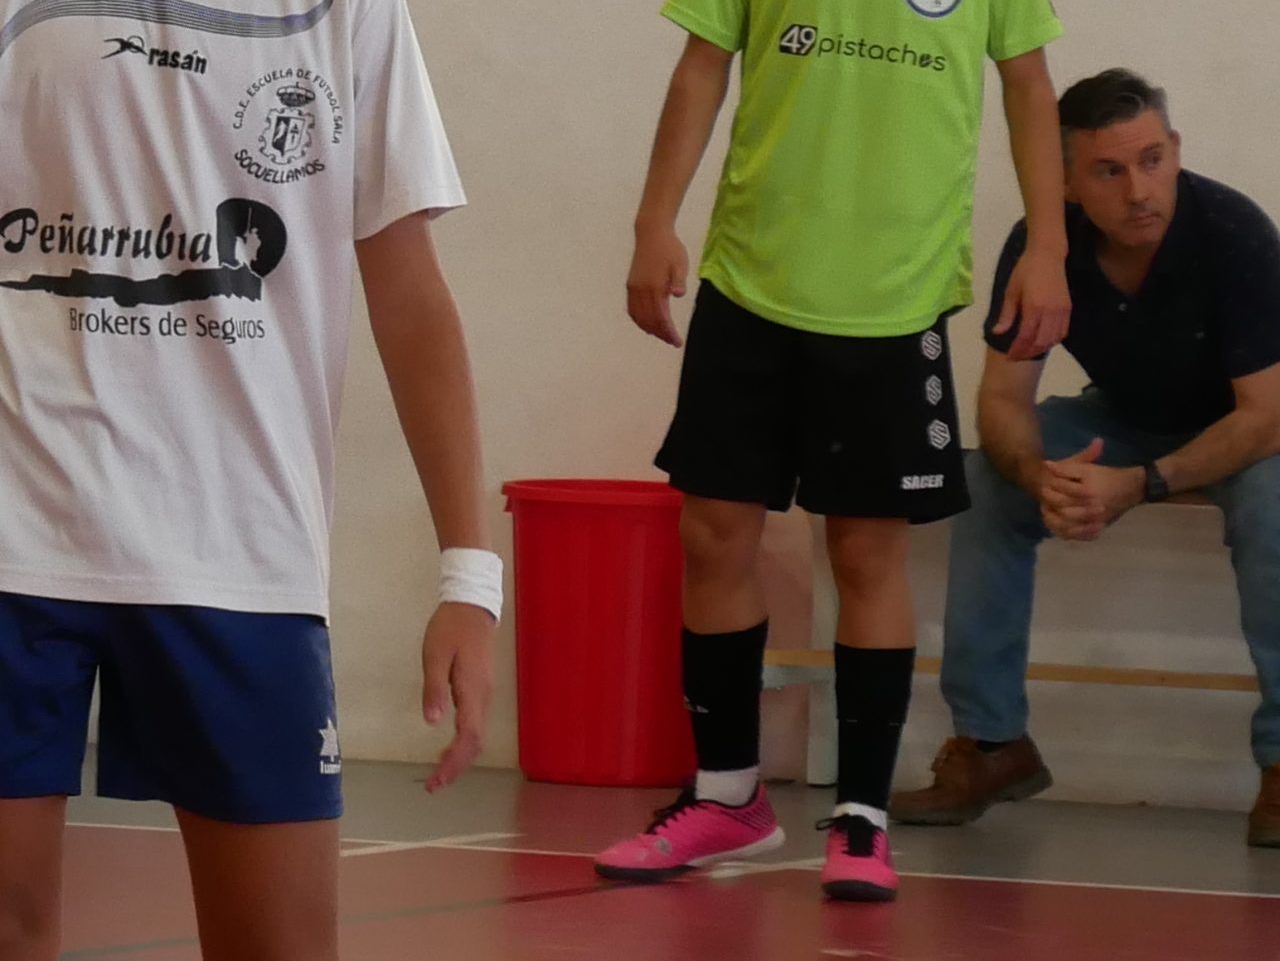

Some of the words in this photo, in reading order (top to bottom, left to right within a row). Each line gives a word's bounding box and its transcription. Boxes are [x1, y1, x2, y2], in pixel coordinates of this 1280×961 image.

[780, 23, 817, 57] 49
[246, 68, 293, 97] ESCUELA
[296, 68, 312, 80] DE
[331, 115, 343, 144] SALA
[234, 148, 325, 184] SOCUELLAMOS
[69, 307, 151, 337] Brokers
[158, 311, 188, 337] de
[195, 313, 265, 345] Seguros
[901, 474, 944, 490] SACER
